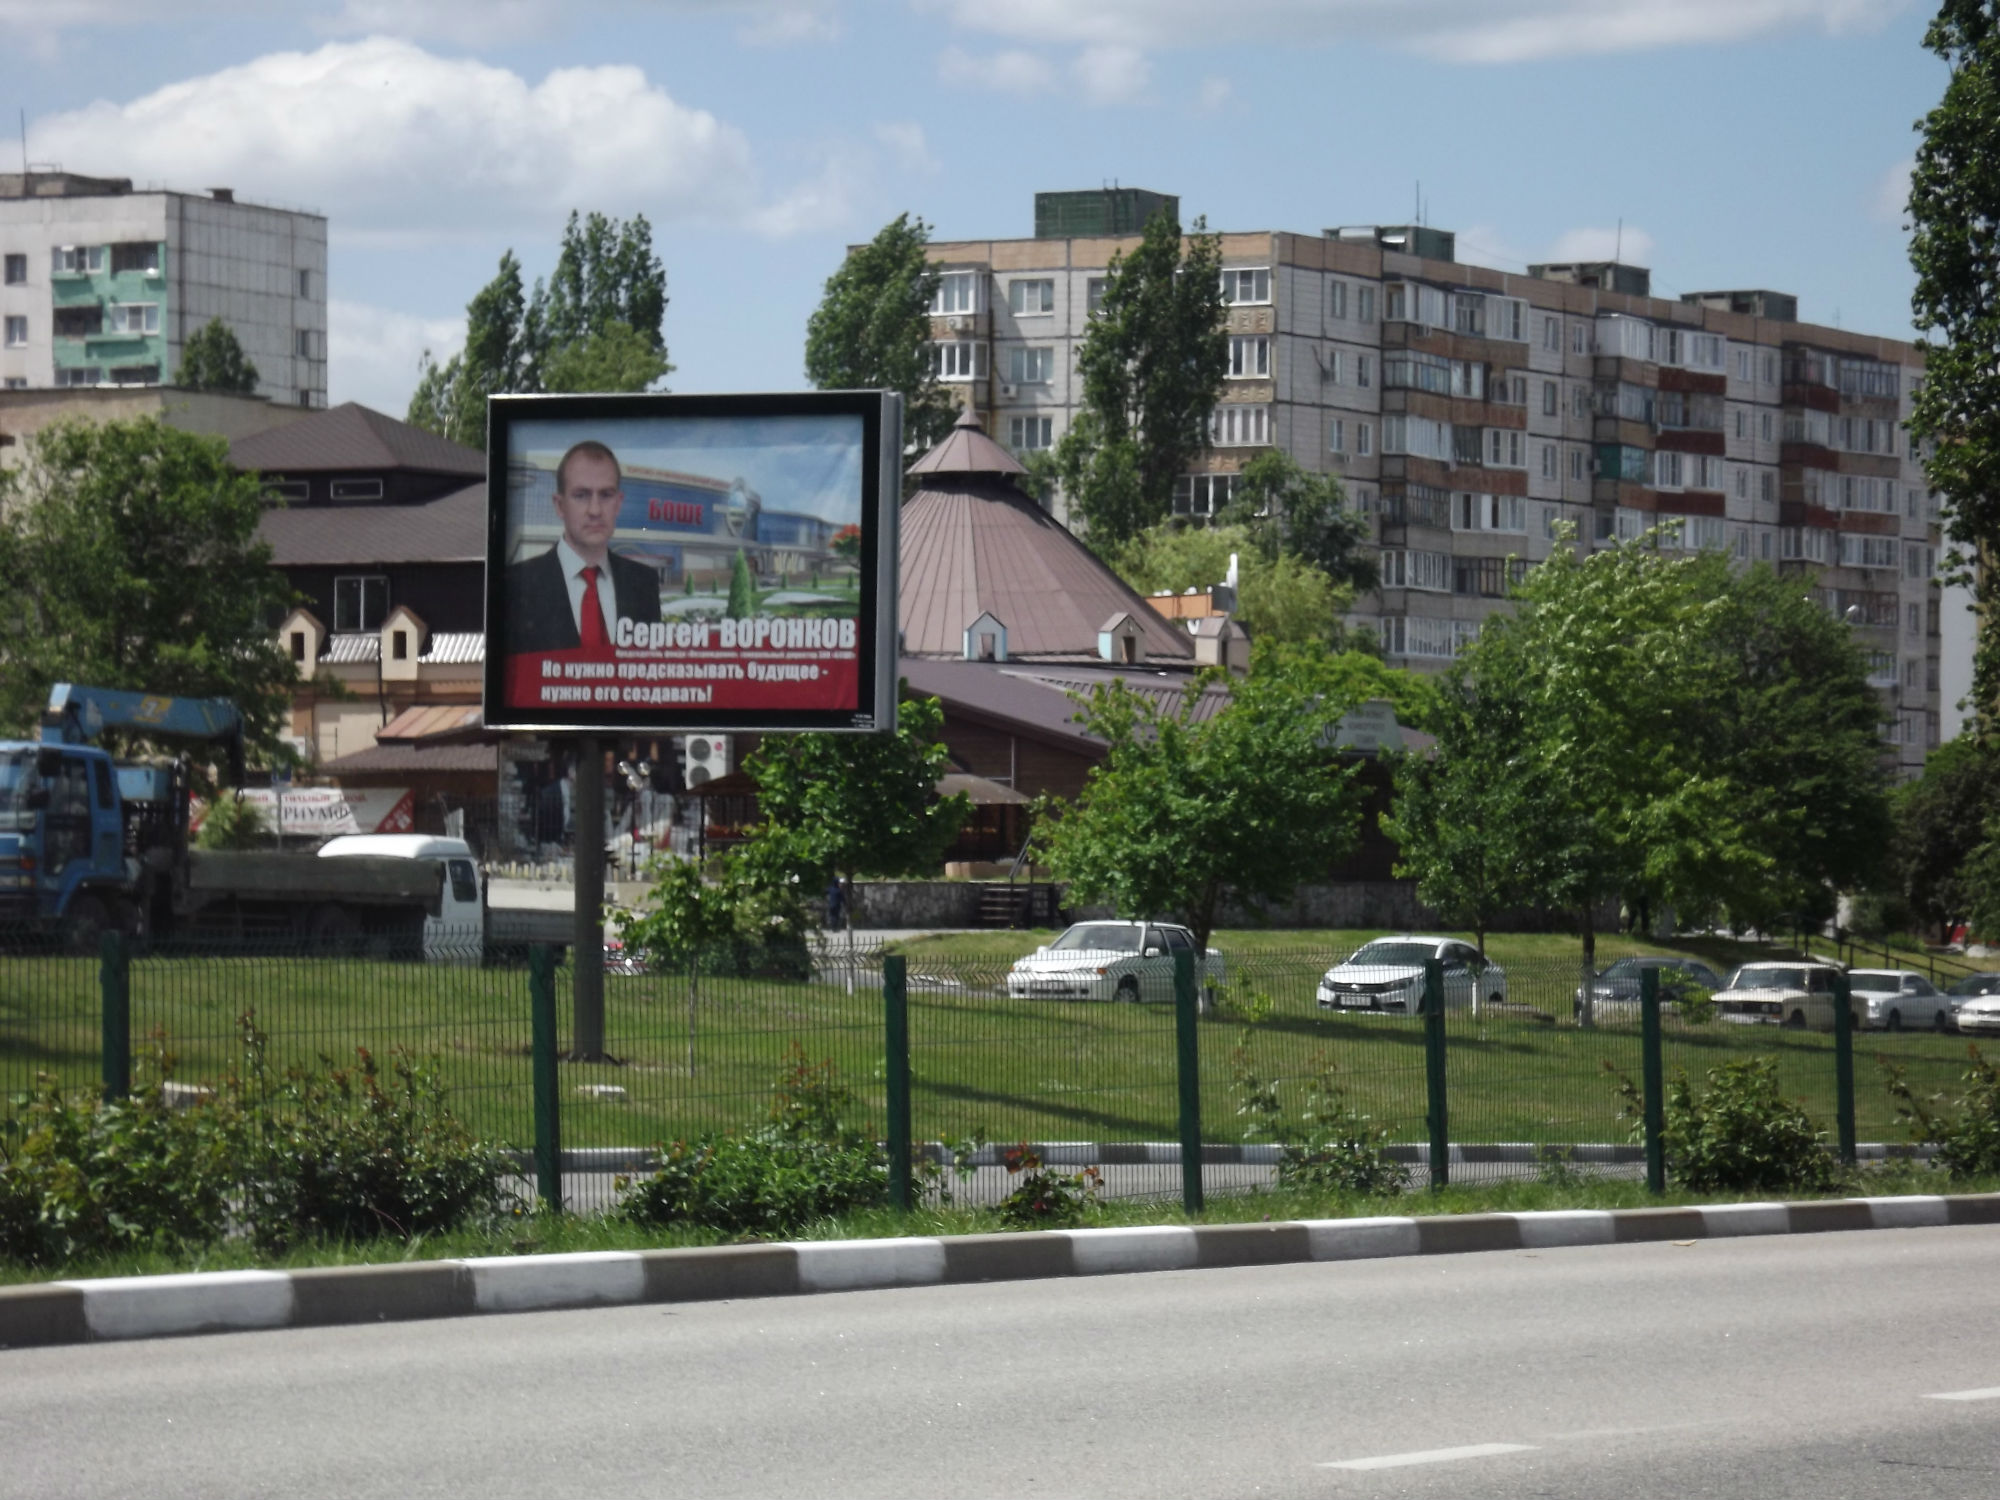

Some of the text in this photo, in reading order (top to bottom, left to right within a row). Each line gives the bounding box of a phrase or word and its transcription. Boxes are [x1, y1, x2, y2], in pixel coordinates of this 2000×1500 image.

[616, 616, 856, 649] Сергей ВОРОНКОВ
[542, 660, 561, 678] Не
[564, 663, 615, 680] нужно
[618, 662, 744, 681] предсказывать
[747, 661, 819, 681] будущее
[541, 685, 712, 703] нужно его создавать!
